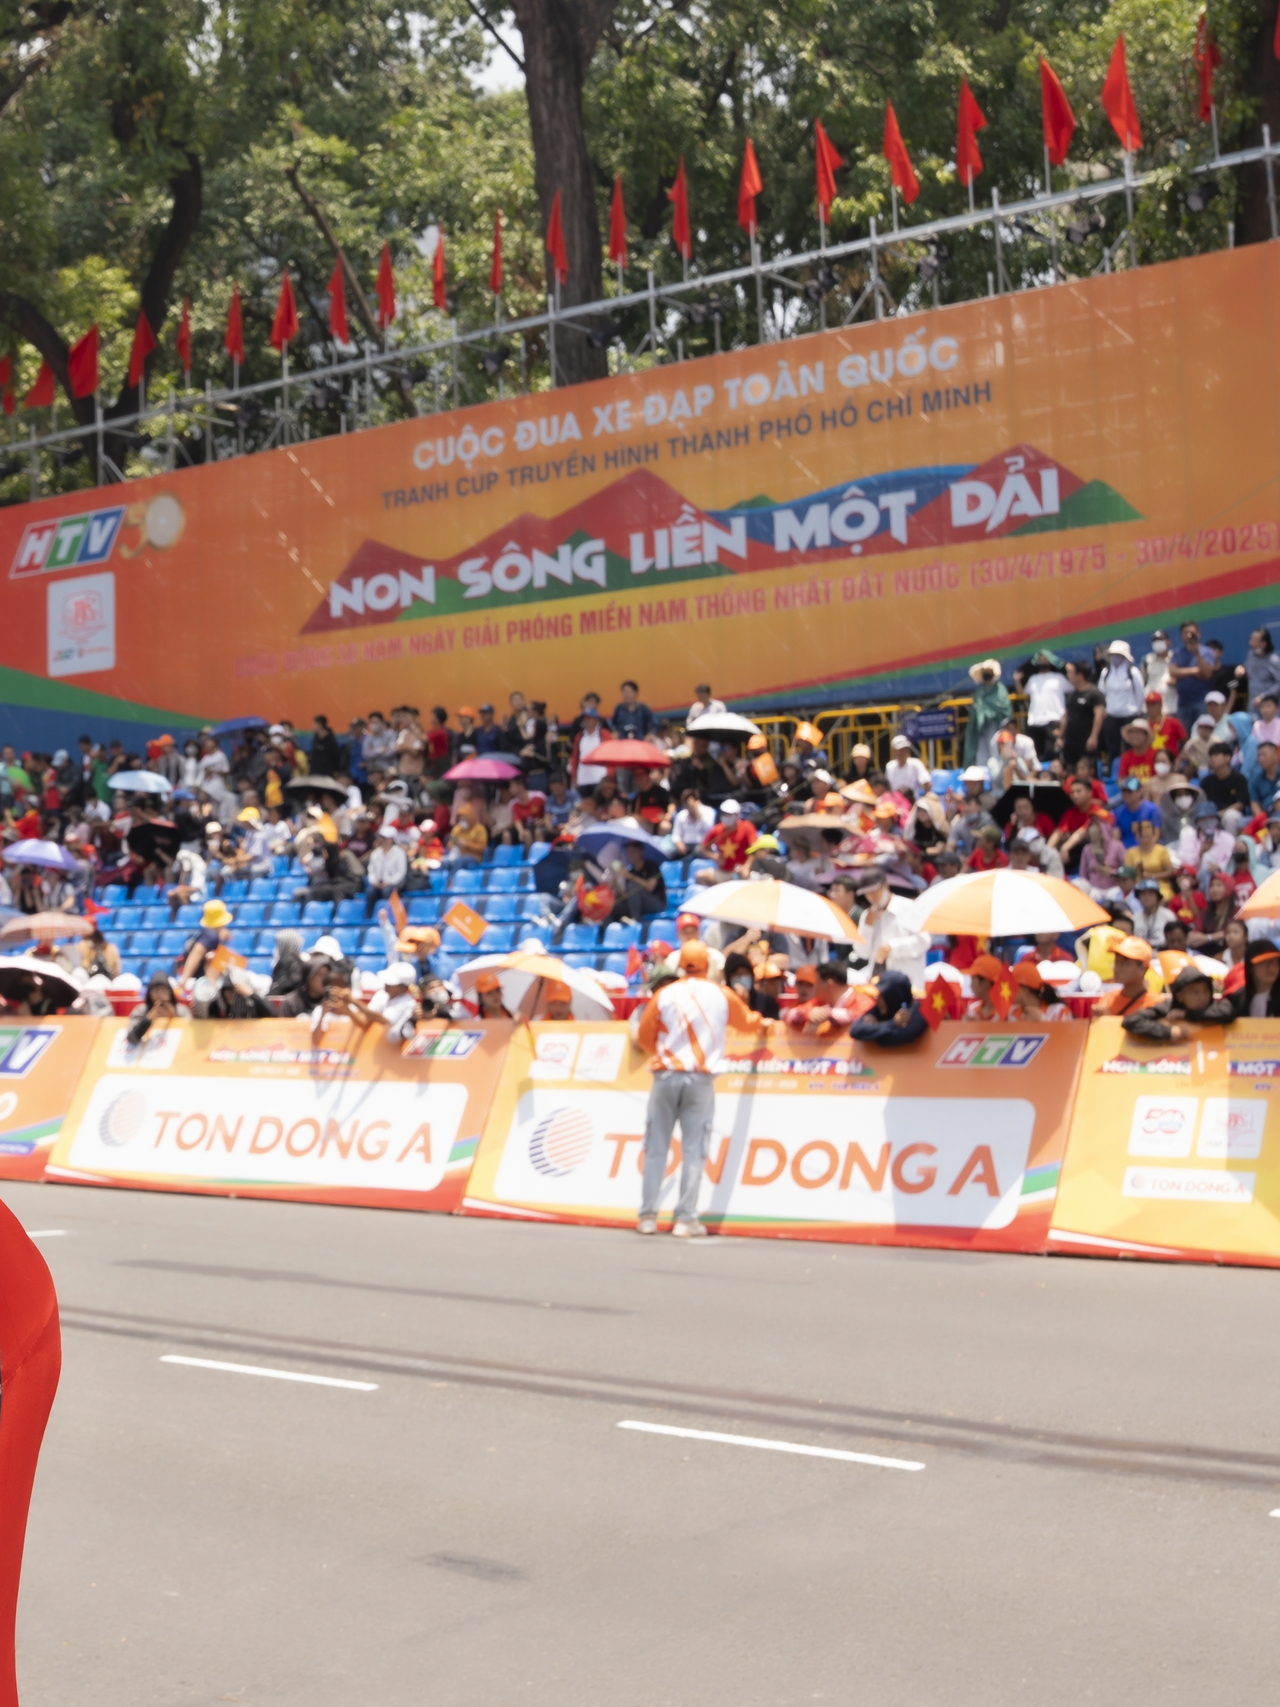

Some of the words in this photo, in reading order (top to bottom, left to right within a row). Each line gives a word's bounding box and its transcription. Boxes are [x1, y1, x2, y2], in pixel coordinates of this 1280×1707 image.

[413, 424, 505, 471] CUỘC
[515, 411, 583, 452] ĐUA
[591, 400, 634, 437] XE
[643, 384, 715, 429] ĐẠP
[723, 359, 825, 410] TOÀN
[837, 327, 959, 388] QUỐC
[382, 482, 449, 510] TRANH
[603, 442, 659, 471] HÌNH
[668, 424, 750, 457] THÀNH
[759, 403, 812, 441] PHỐ
[867, 388, 912, 423] CHÍ
[922, 380, 992, 412] MINH
[16, 514, 120, 570] HTV
[329, 565, 436, 617] NON
[457, 539, 606, 600] SÔNG
[629, 502, 747, 574] LIỀN
[772, 486, 917, 555] MỘT
[949, 454, 1061, 534] DẢI
[409, 626, 456, 658] NGÀY
[462, 616, 500, 650] GIẢI
[507, 612, 573, 645] PHÓNG
[695, 583, 766, 621] THỐNG
[774, 574, 834, 611] NHẤT
[841, 565, 886, 604] ĐẤT
[894, 558, 960, 597] NƯỚC
[970, 543, 1107, 589] (30/4/1975
[412, 1033, 479, 1057] HTV
[946, 1038, 1037, 1062] HTV
[1236, 1060, 1277, 1077] MỘT
[153, 1111, 245, 1153] TON
[248, 1115, 393, 1162] DONG
[396, 1122, 432, 1164] A
[741, 1138, 938, 1194] DONG
[946, 1144, 1001, 1197] A
[1151, 1179, 1182, 1191] TON
[1185, 1181, 1231, 1194] DONG
[1235, 1182, 1245, 1194] A
